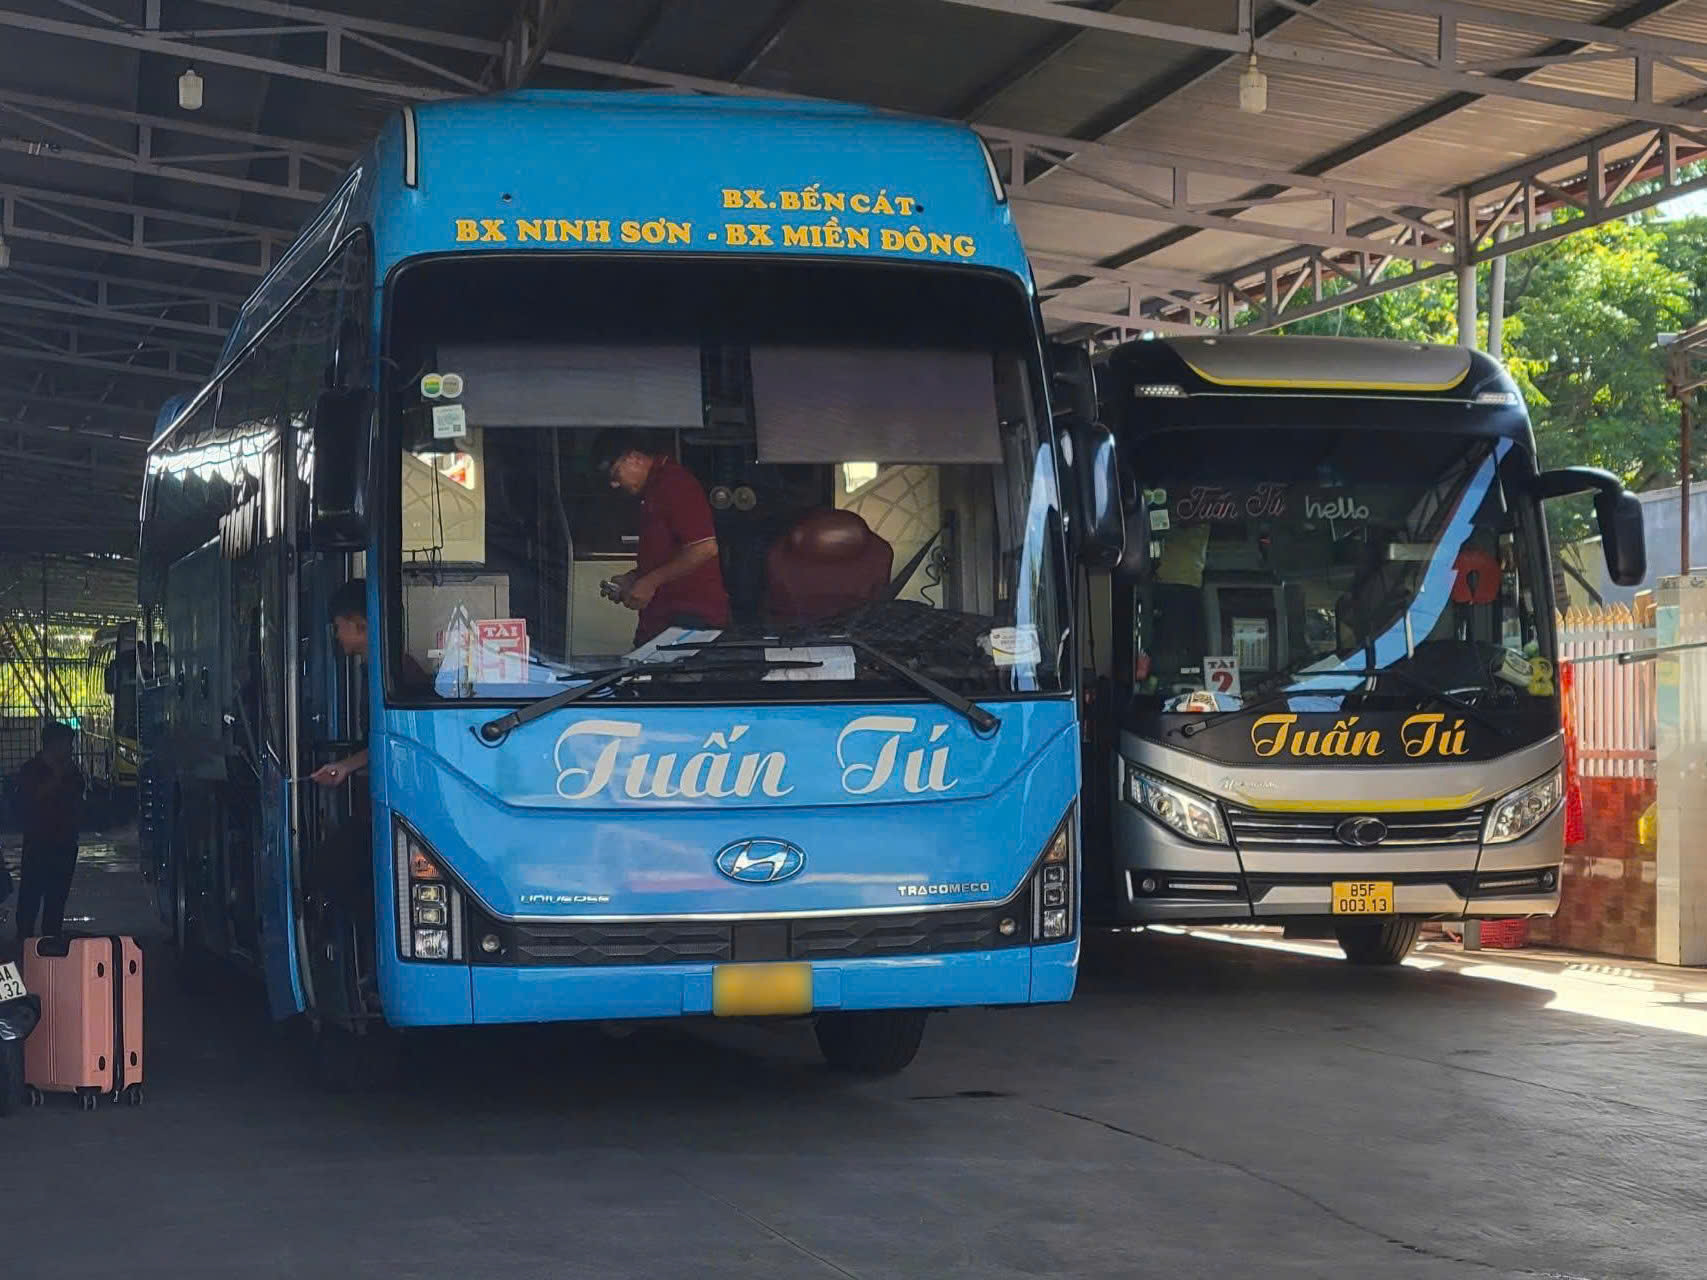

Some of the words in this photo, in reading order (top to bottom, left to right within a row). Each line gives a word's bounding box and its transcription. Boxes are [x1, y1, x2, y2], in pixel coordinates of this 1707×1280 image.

[456, 219, 507, 242] BX
[516, 220, 611, 242] NINH
[620, 217, 692, 244] SƠN
[725, 224, 774, 246] BX
[782, 215, 870, 249] MIỀN
[880, 225, 977, 257] ĐÔNG
[1305, 495, 1370, 519] hello
[483, 623, 518, 638] TÀI
[1207, 659, 1235, 669] TÀI
[1251, 713, 1386, 757] Tuấn
[1401, 713, 1470, 757] Tú
[554, 719, 795, 800] Tuấn
[836, 715, 959, 795] Tú
[898, 882, 990, 897] TRACOMECO
[1350, 883, 1376, 897] 85F
[1340, 898, 1387, 913] 003.13
